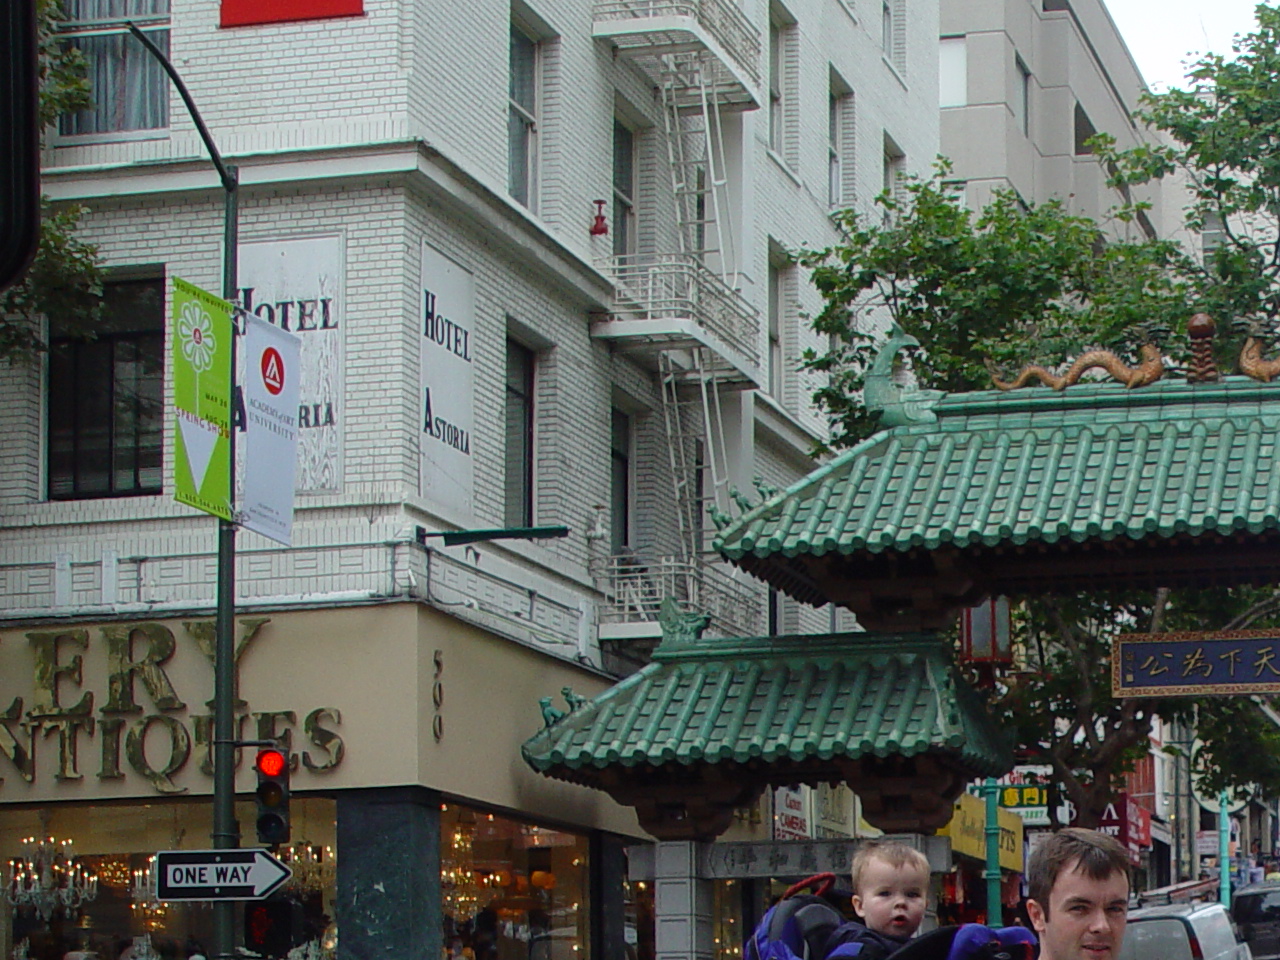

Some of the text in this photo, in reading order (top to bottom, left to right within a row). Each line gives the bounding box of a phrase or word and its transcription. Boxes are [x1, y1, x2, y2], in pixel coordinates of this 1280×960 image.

[425, 289, 472, 363] HOTEL
[236, 385, 336, 433] ARIA
[250, 412, 295, 442] UNIVERSITY
[424, 386, 471, 456] ASTORIA
[0, 617, 271, 722] ERY
[0, 707, 346, 794] NTIQUES
[172, 866, 252, 885] ONE WAY
